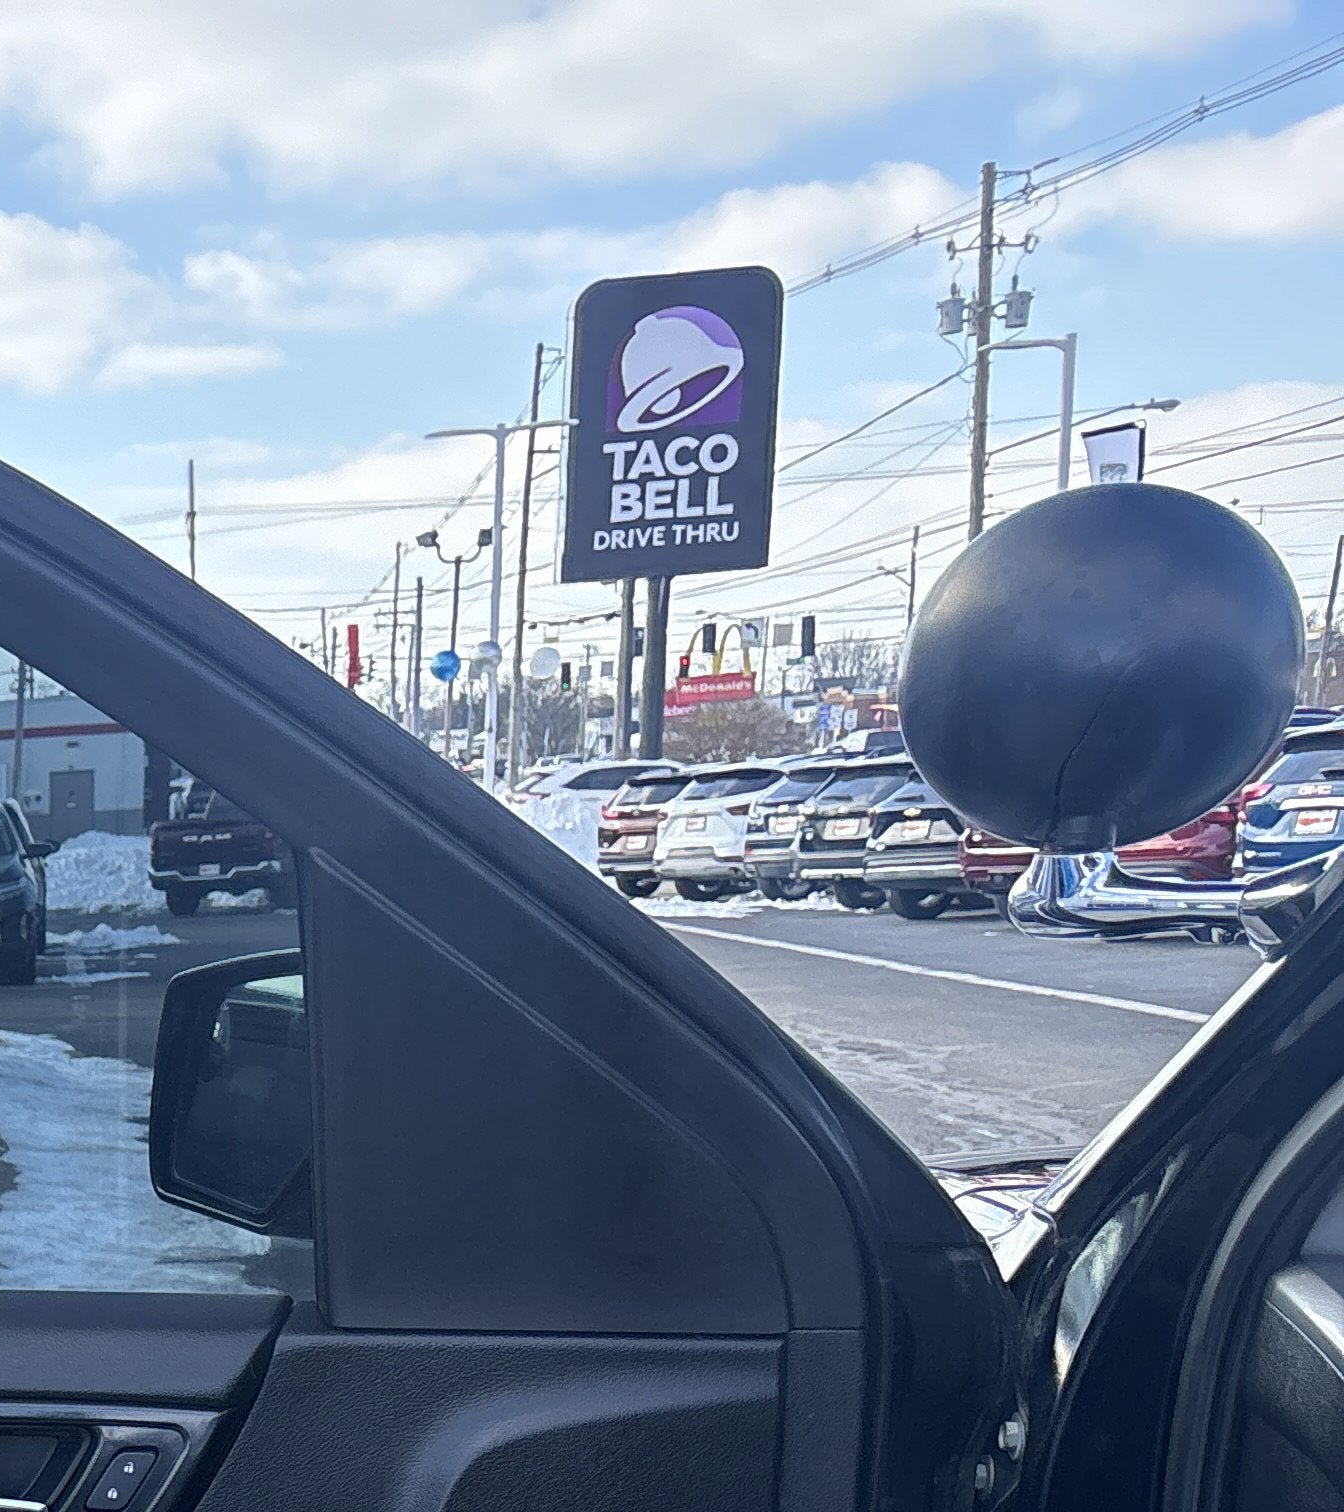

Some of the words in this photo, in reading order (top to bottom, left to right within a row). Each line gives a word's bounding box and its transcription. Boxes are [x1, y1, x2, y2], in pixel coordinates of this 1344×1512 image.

[603, 433, 739, 481] TACO
[610, 476, 734, 523] BELL
[593, 524, 666, 551] DRIVE
[671, 521, 740, 545] THRU
[680, 679, 752, 695] McDonald's
